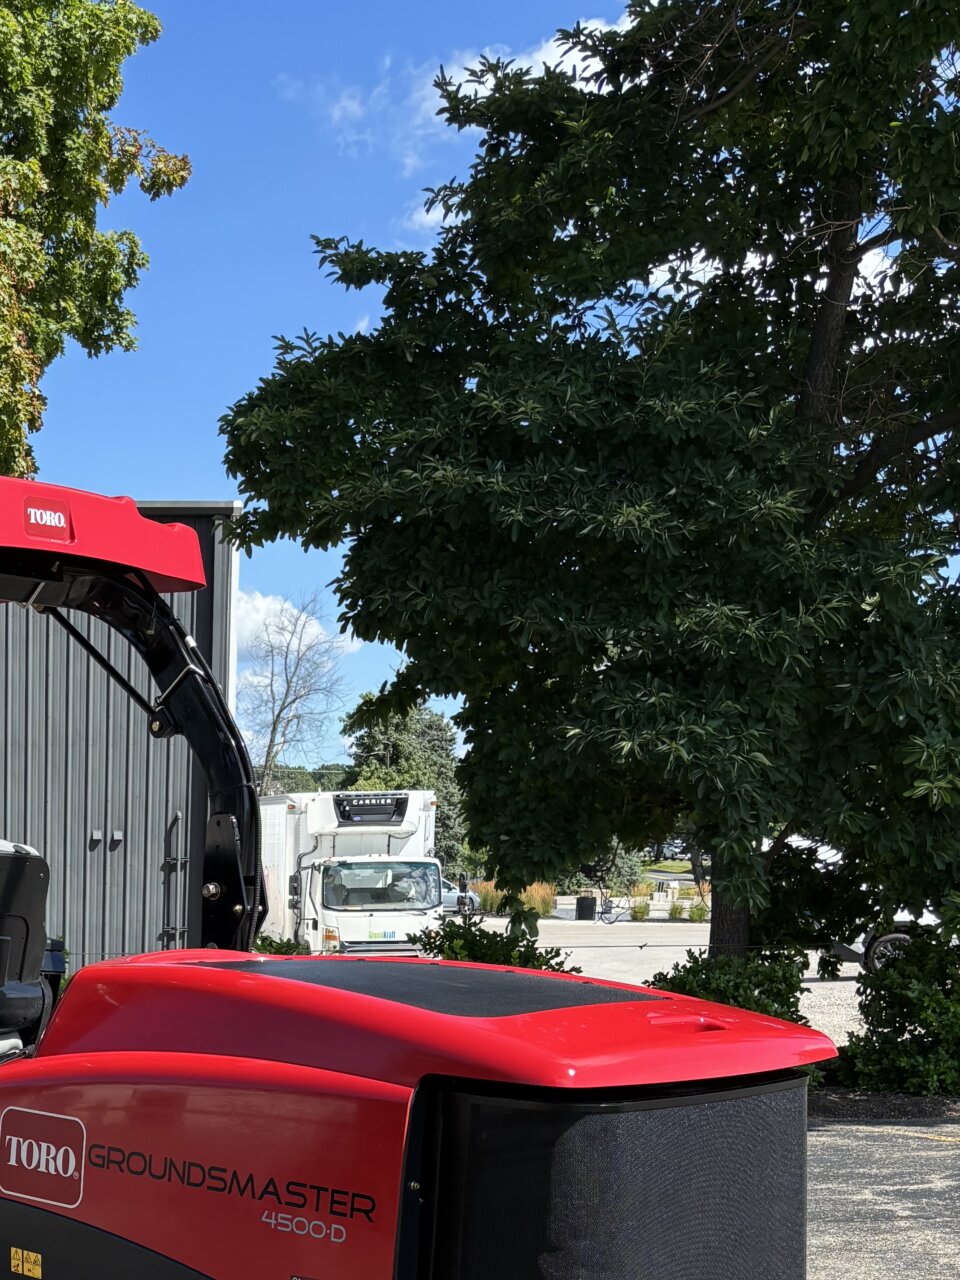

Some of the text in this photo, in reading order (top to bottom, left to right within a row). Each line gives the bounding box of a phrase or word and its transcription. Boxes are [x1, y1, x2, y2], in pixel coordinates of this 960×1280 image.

[27, 507, 65, 528] TORO
[352, 798, 392, 806] CARRIER
[5, 1135, 77, 1179] TORO
[88, 1143, 377, 1223] GROUNDSMASTER
